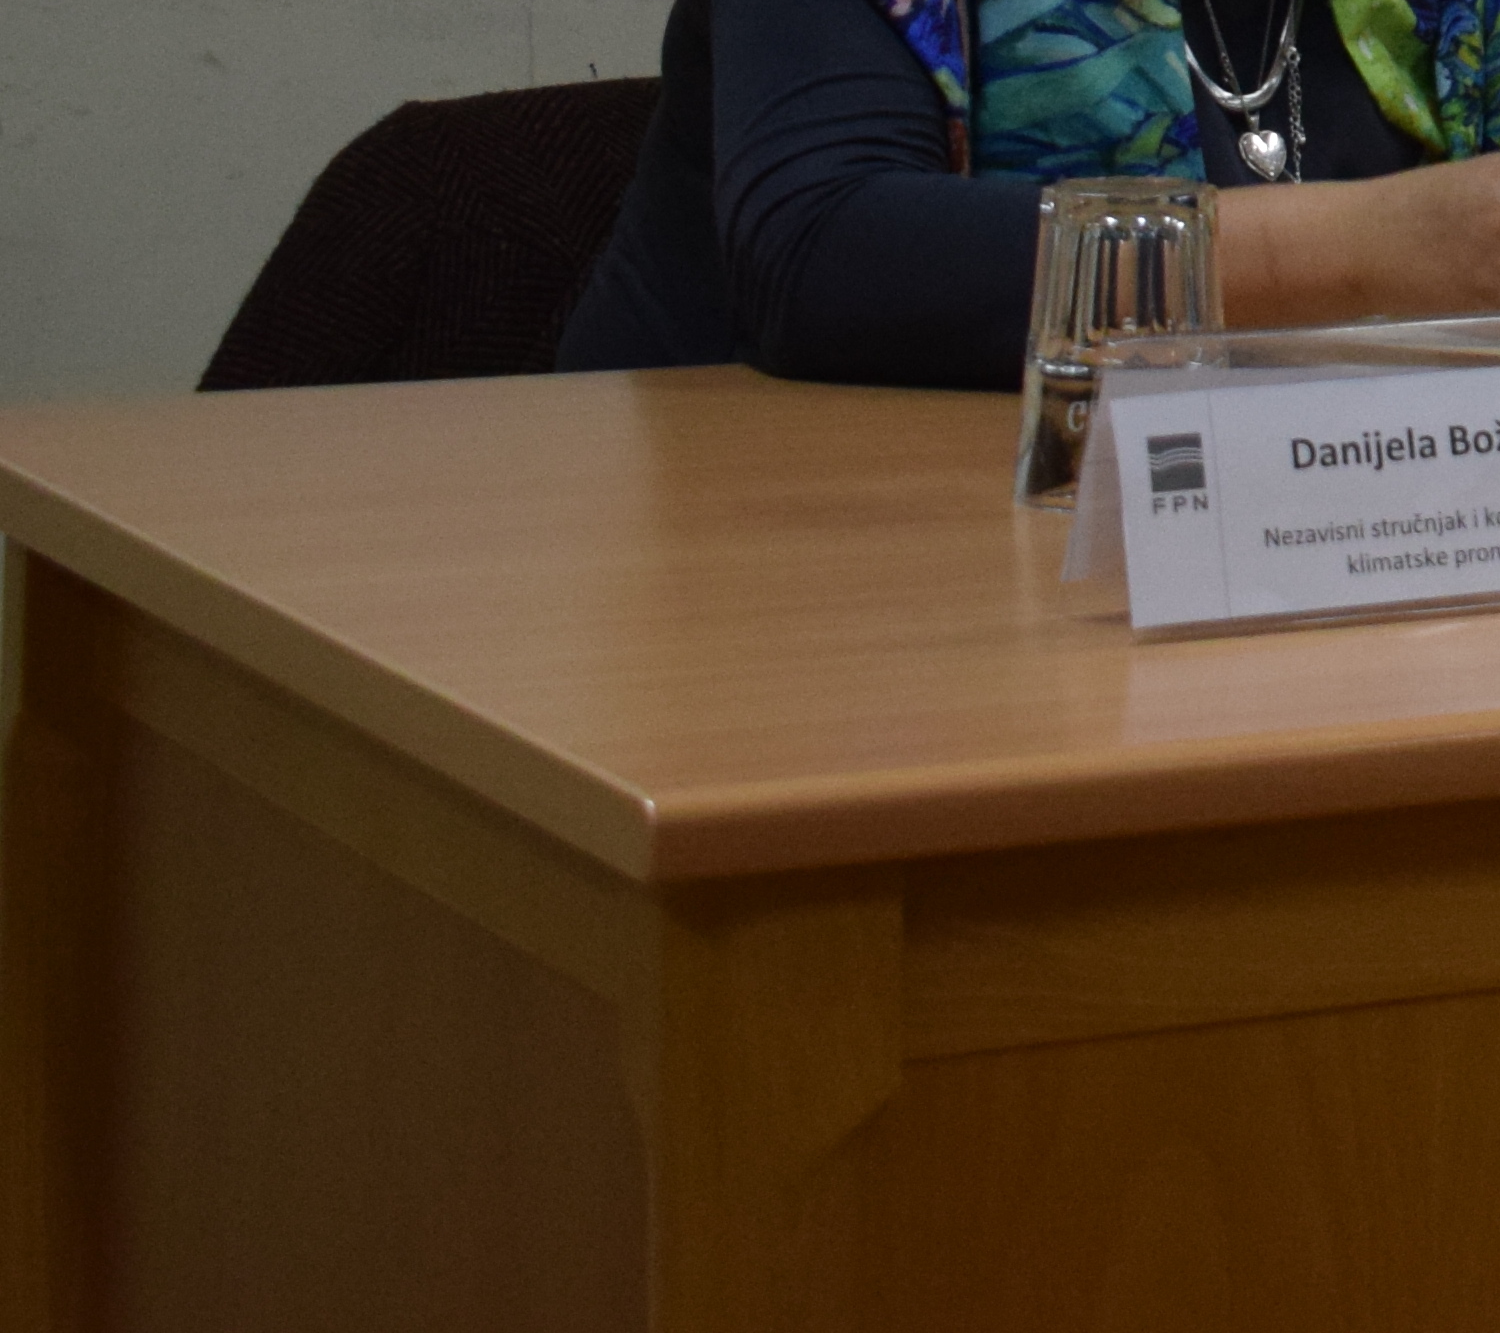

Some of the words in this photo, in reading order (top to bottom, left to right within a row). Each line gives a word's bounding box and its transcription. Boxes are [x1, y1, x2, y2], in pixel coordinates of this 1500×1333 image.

[1291, 427, 1437, 471] Danijela
[1152, 494, 1208, 514] FPN
[1264, 519, 1365, 549] Nezavisni
[1371, 509, 1467, 539] stručnjak
[1474, 508, 1479, 528] i
[1347, 547, 1448, 575] klimatske
